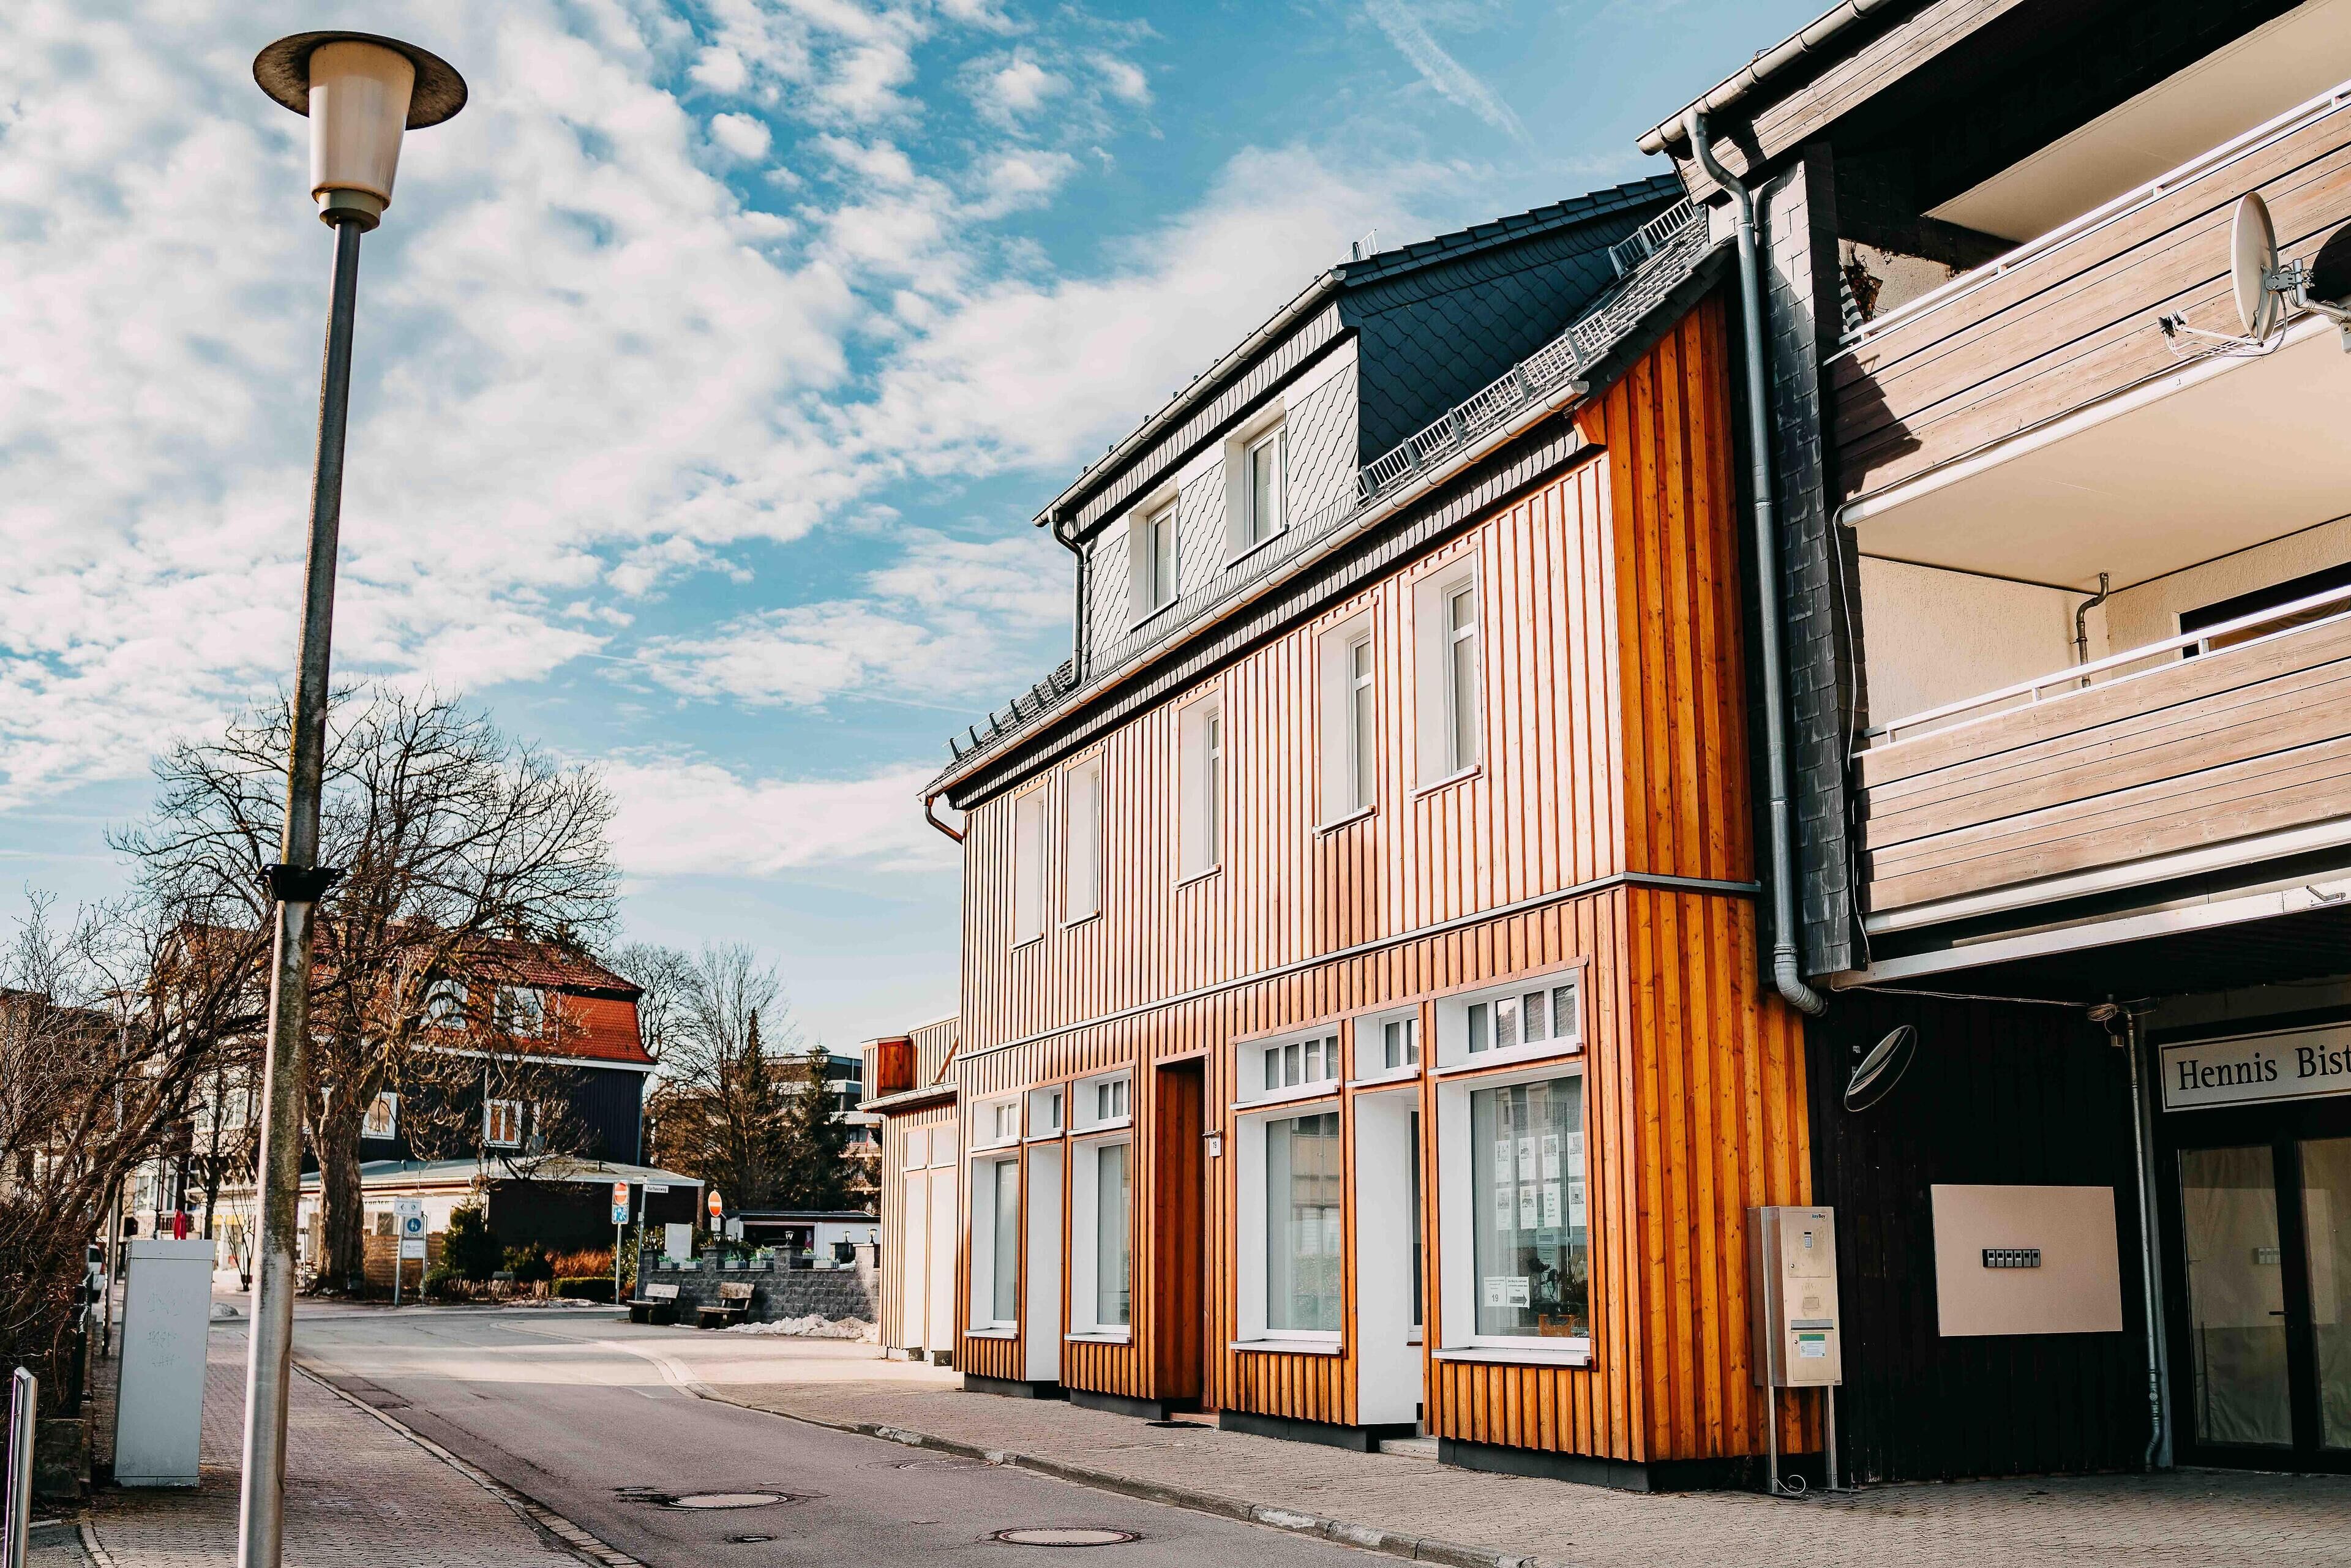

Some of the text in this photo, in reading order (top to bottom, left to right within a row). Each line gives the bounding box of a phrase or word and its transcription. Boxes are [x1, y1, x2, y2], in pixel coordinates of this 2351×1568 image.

[2177, 1044, 2351, 1090] Hennis Bist
[1491, 1294, 1499, 1302] 19
